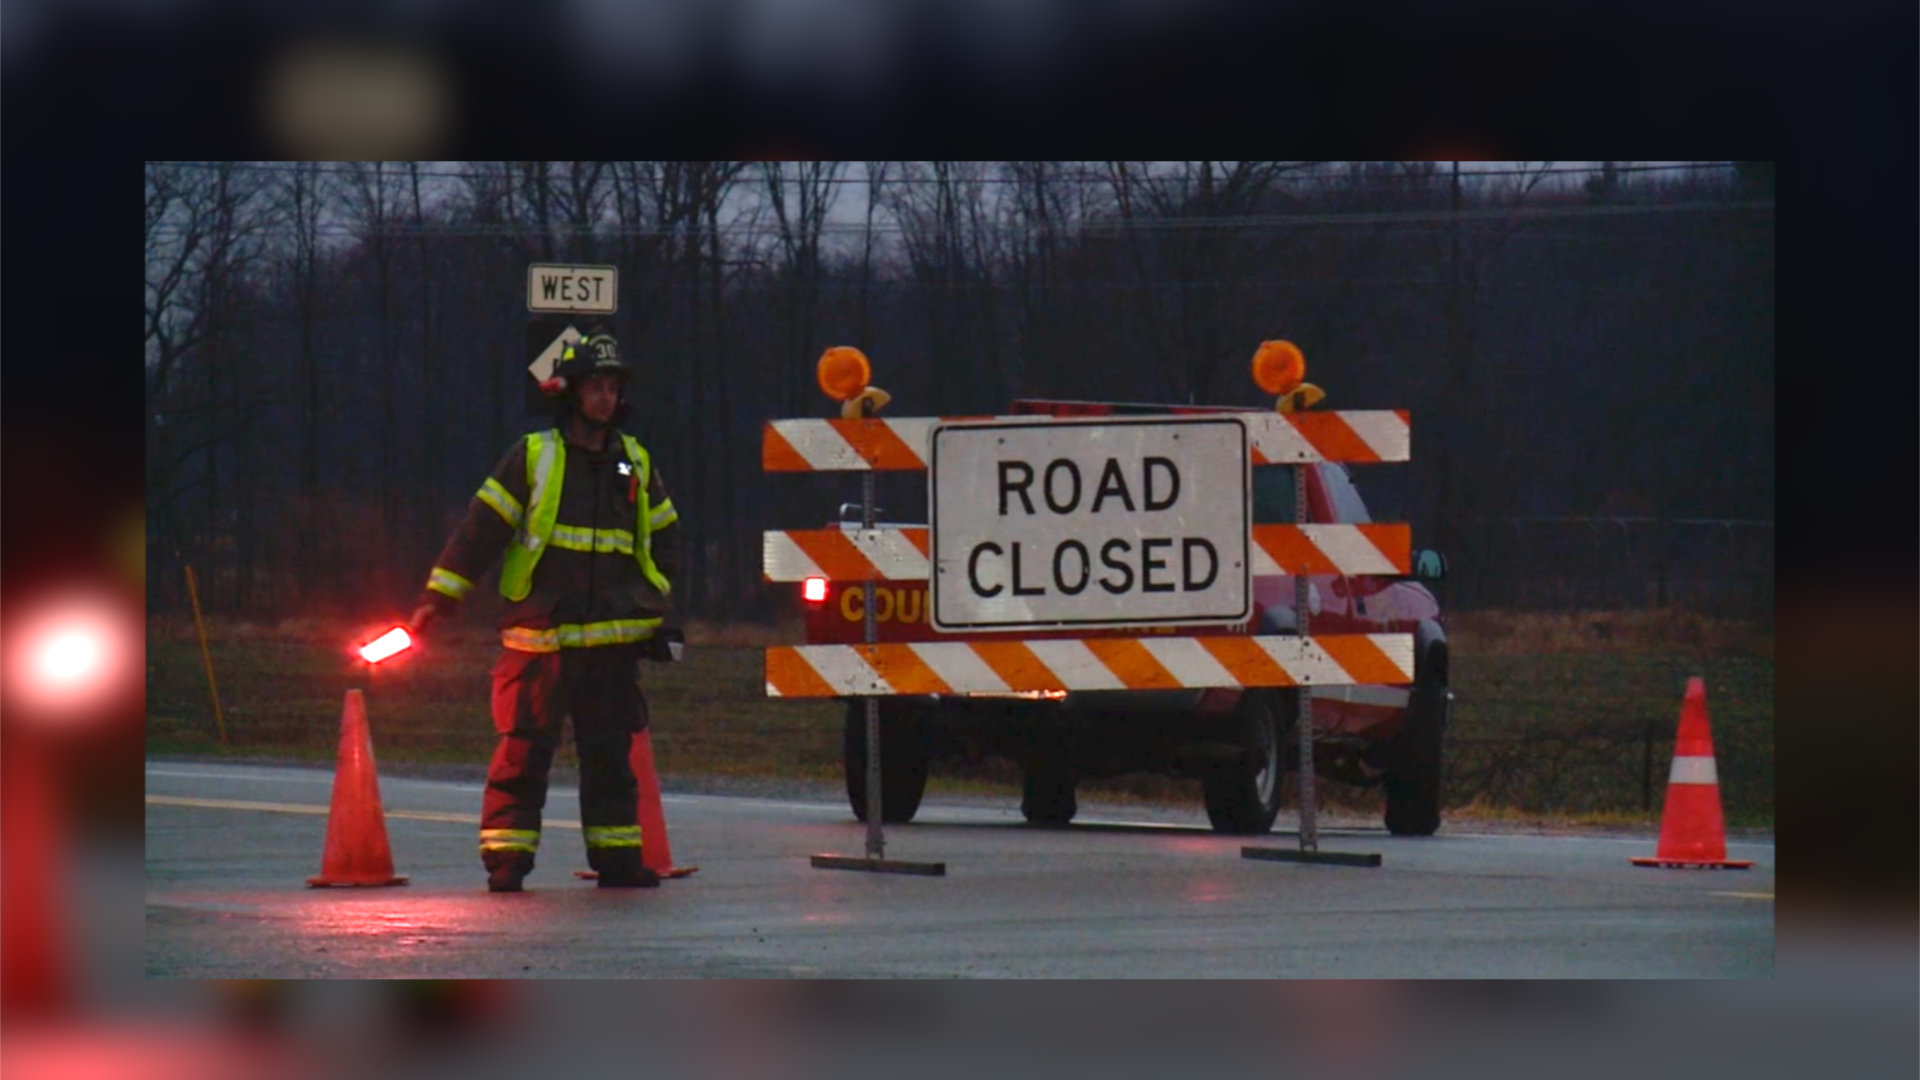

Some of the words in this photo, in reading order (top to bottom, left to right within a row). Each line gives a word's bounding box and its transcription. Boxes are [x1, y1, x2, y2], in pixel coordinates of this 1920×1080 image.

[542, 275, 604, 302] WEST
[595, 342, 617, 359] 30
[997, 456, 1182, 516] ROAD
[967, 537, 1219, 598] CLOSED
